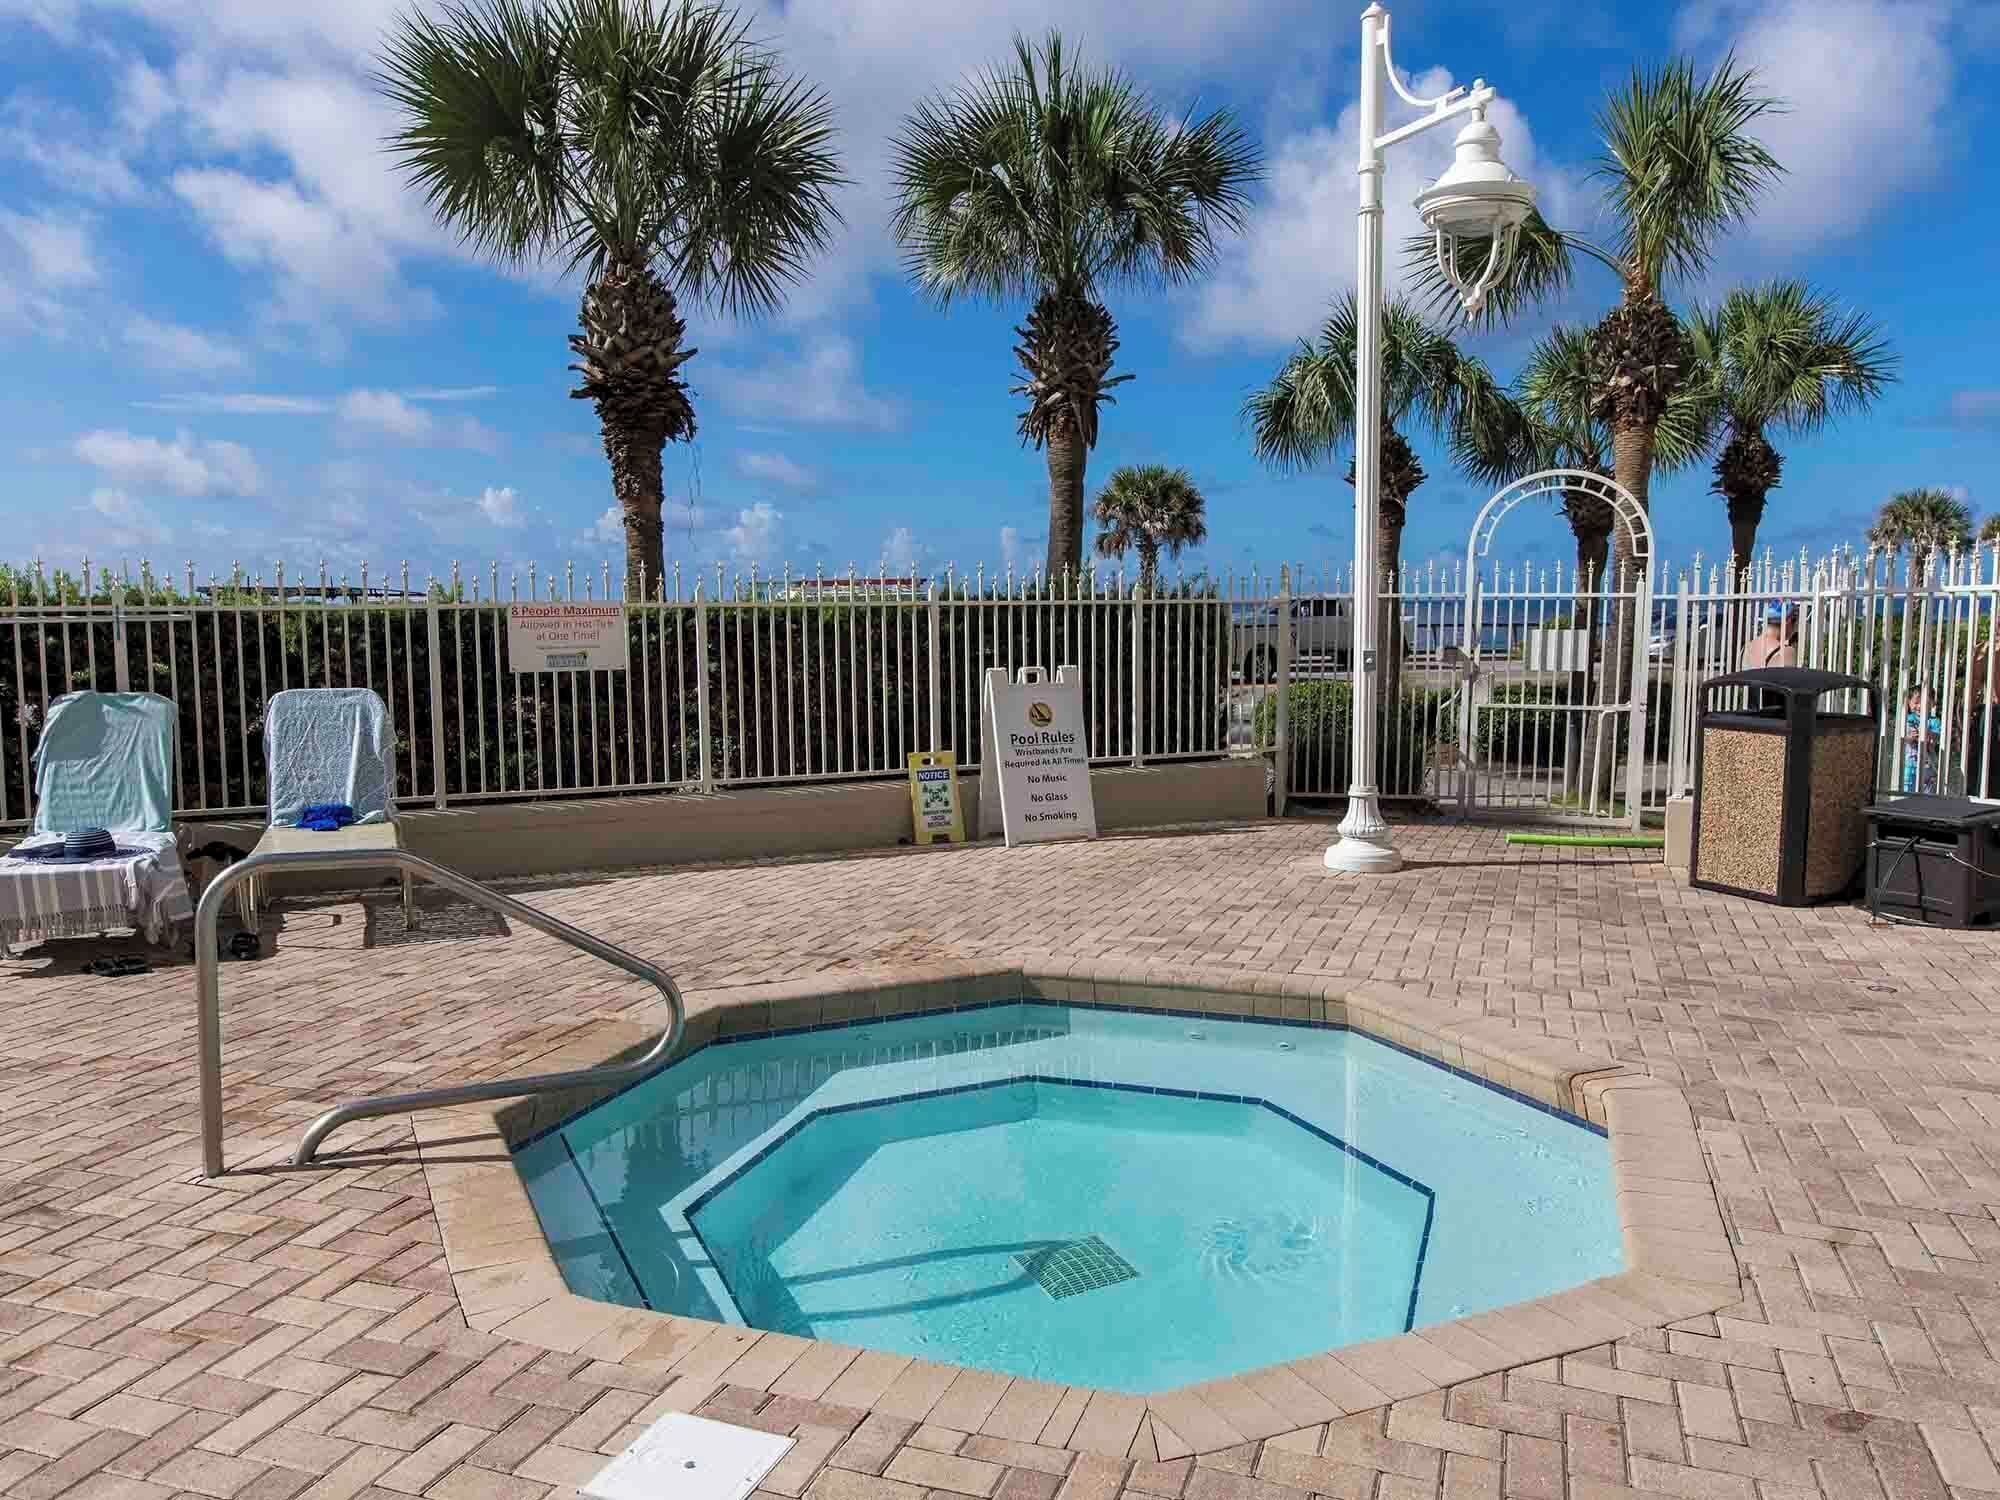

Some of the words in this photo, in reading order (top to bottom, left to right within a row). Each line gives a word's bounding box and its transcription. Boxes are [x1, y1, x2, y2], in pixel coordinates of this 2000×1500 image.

[511, 606, 519, 616] 8
[521, 606, 560, 617] People
[563, 605, 620, 616] Maximum
[520, 619, 560, 629] Allowed
[548, 631, 569, 641] One
[1010, 731, 1039, 745] Pool
[1041, 730, 1075, 744] Rules
[1015, 746, 1059, 757] Wristbands
[1060, 746, 1073, 754] Are
[1005, 758, 1040, 769] Required
[1042, 757, 1050, 766] At
[1052, 757, 1062, 766] All
[1063, 756, 1085, 766] Times
[918, 769, 949, 781] NOTICE
[1028, 775, 1041, 784] No
[1042, 774, 1068, 783] Music
[1031, 794, 1044, 803] No
[1045, 793, 1068, 802] Glass
[1025, 813, 1038, 822] No
[1039, 811, 1078, 821] Smoking
